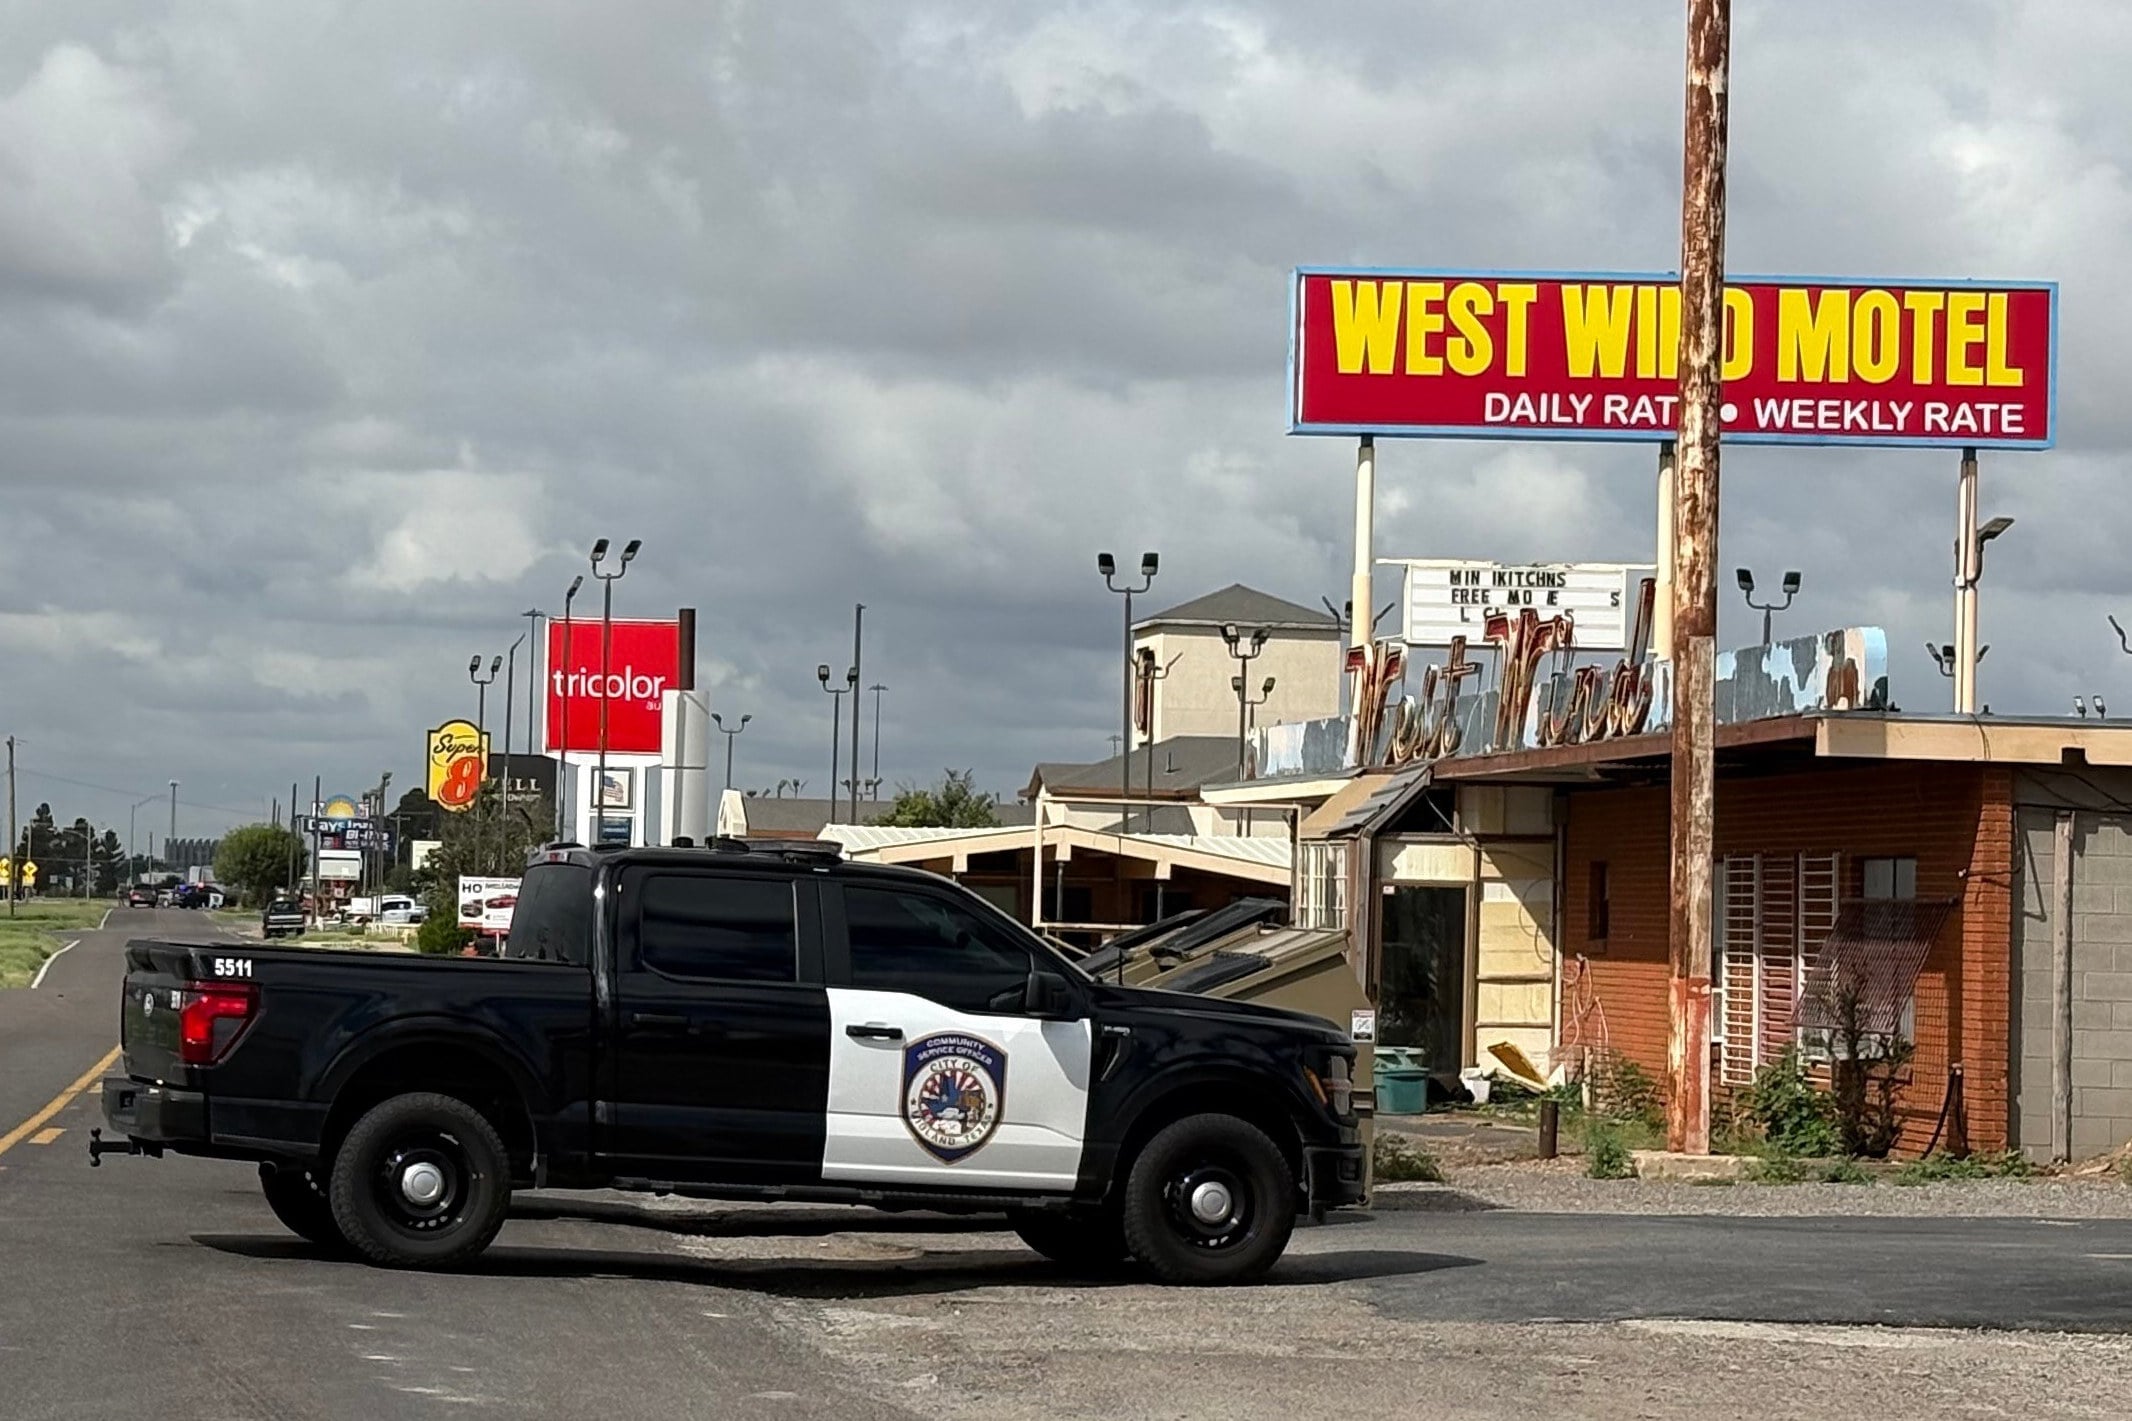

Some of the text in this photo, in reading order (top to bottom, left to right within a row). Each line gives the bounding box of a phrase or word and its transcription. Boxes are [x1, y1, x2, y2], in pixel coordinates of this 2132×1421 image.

[1331, 280, 1538, 376] WEST
[1777, 288, 2025, 387] MOTEL
[1484, 392, 2026, 434] DAILY RAT WEEKLY RATE
[1451, 588, 1491, 604] FREE
[552, 664, 667, 702] tricolor
[438, 756, 485, 806] 8
[214, 957, 252, 977] 5511
[926, 1037, 985, 1051] COMMUNITY
[917, 1046, 993, 1065] SERVICE OFFICER
[930, 1059, 980, 1073] CITY OF
